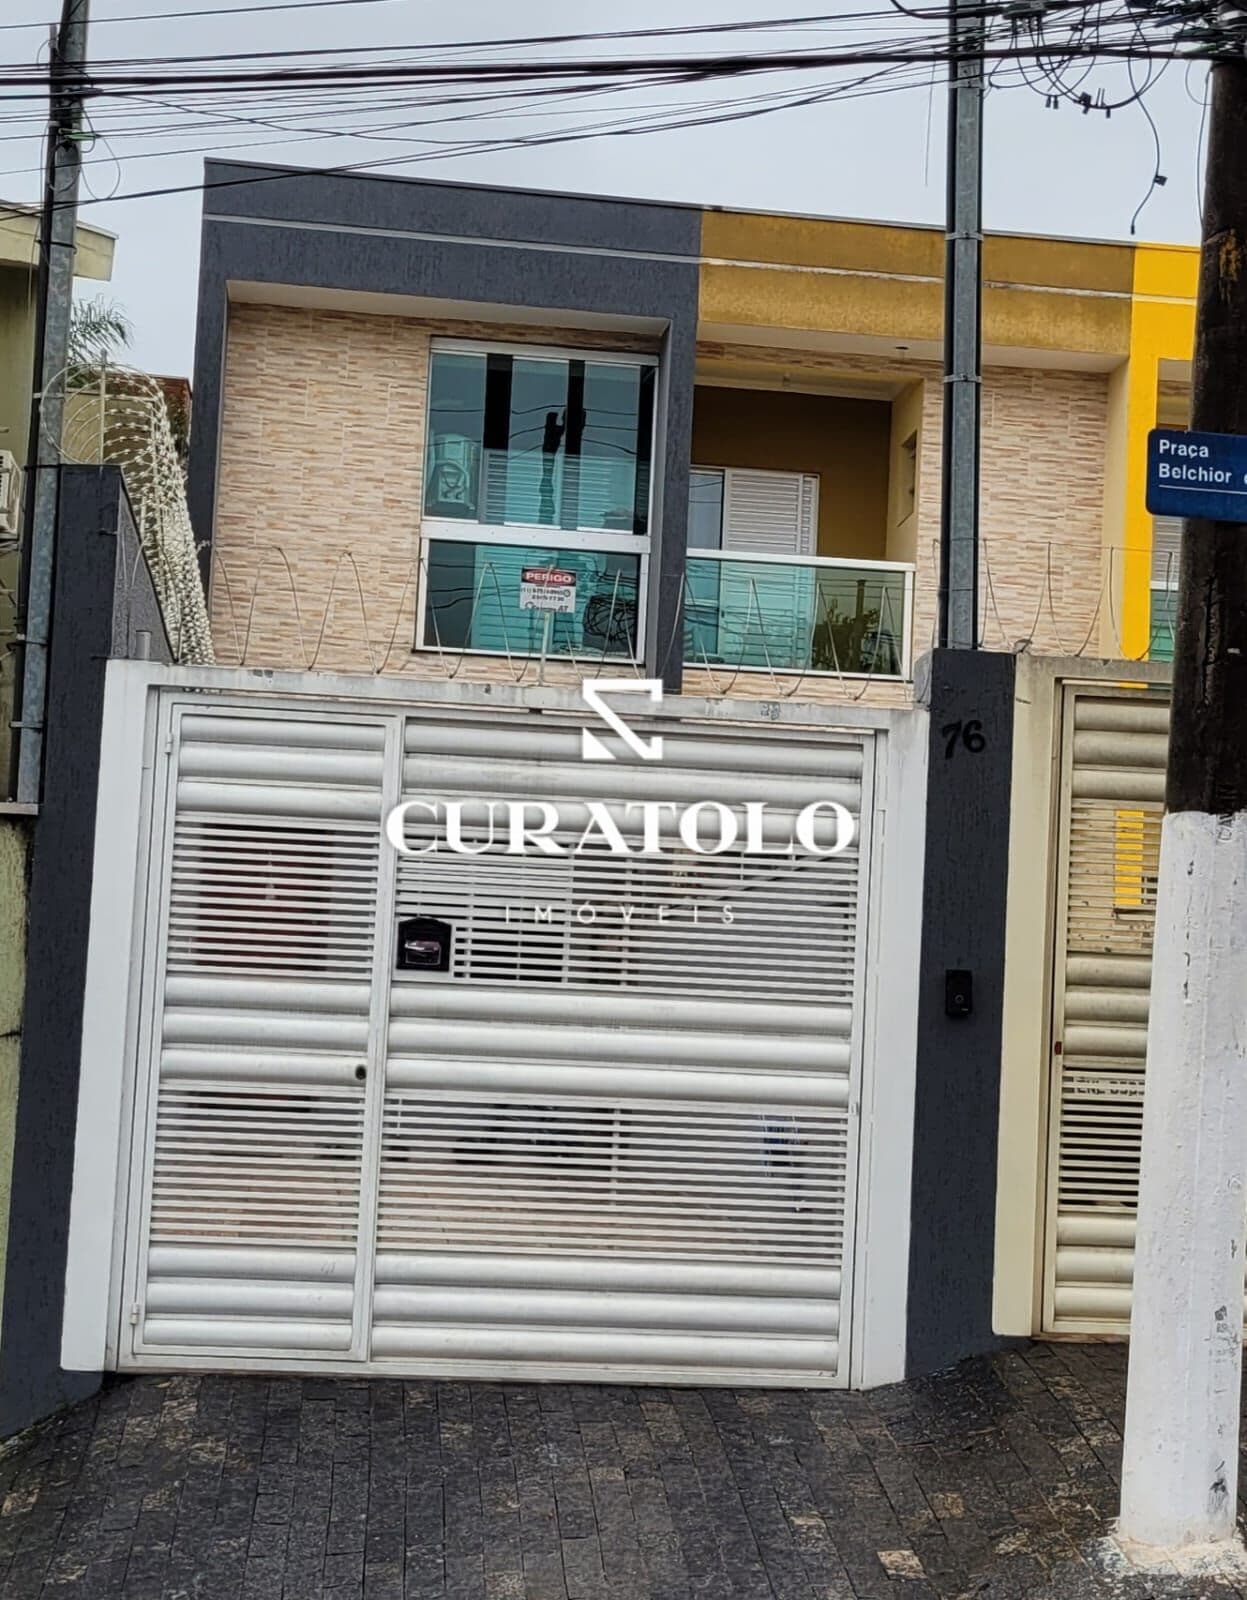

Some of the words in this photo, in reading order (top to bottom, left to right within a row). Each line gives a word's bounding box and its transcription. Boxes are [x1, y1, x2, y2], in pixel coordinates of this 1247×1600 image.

[1159, 439, 1209, 459] Praça
[1158, 463, 1232, 483] Belchior
[525, 572, 572, 583] PERIGO
[942, 719, 986, 760] 76
